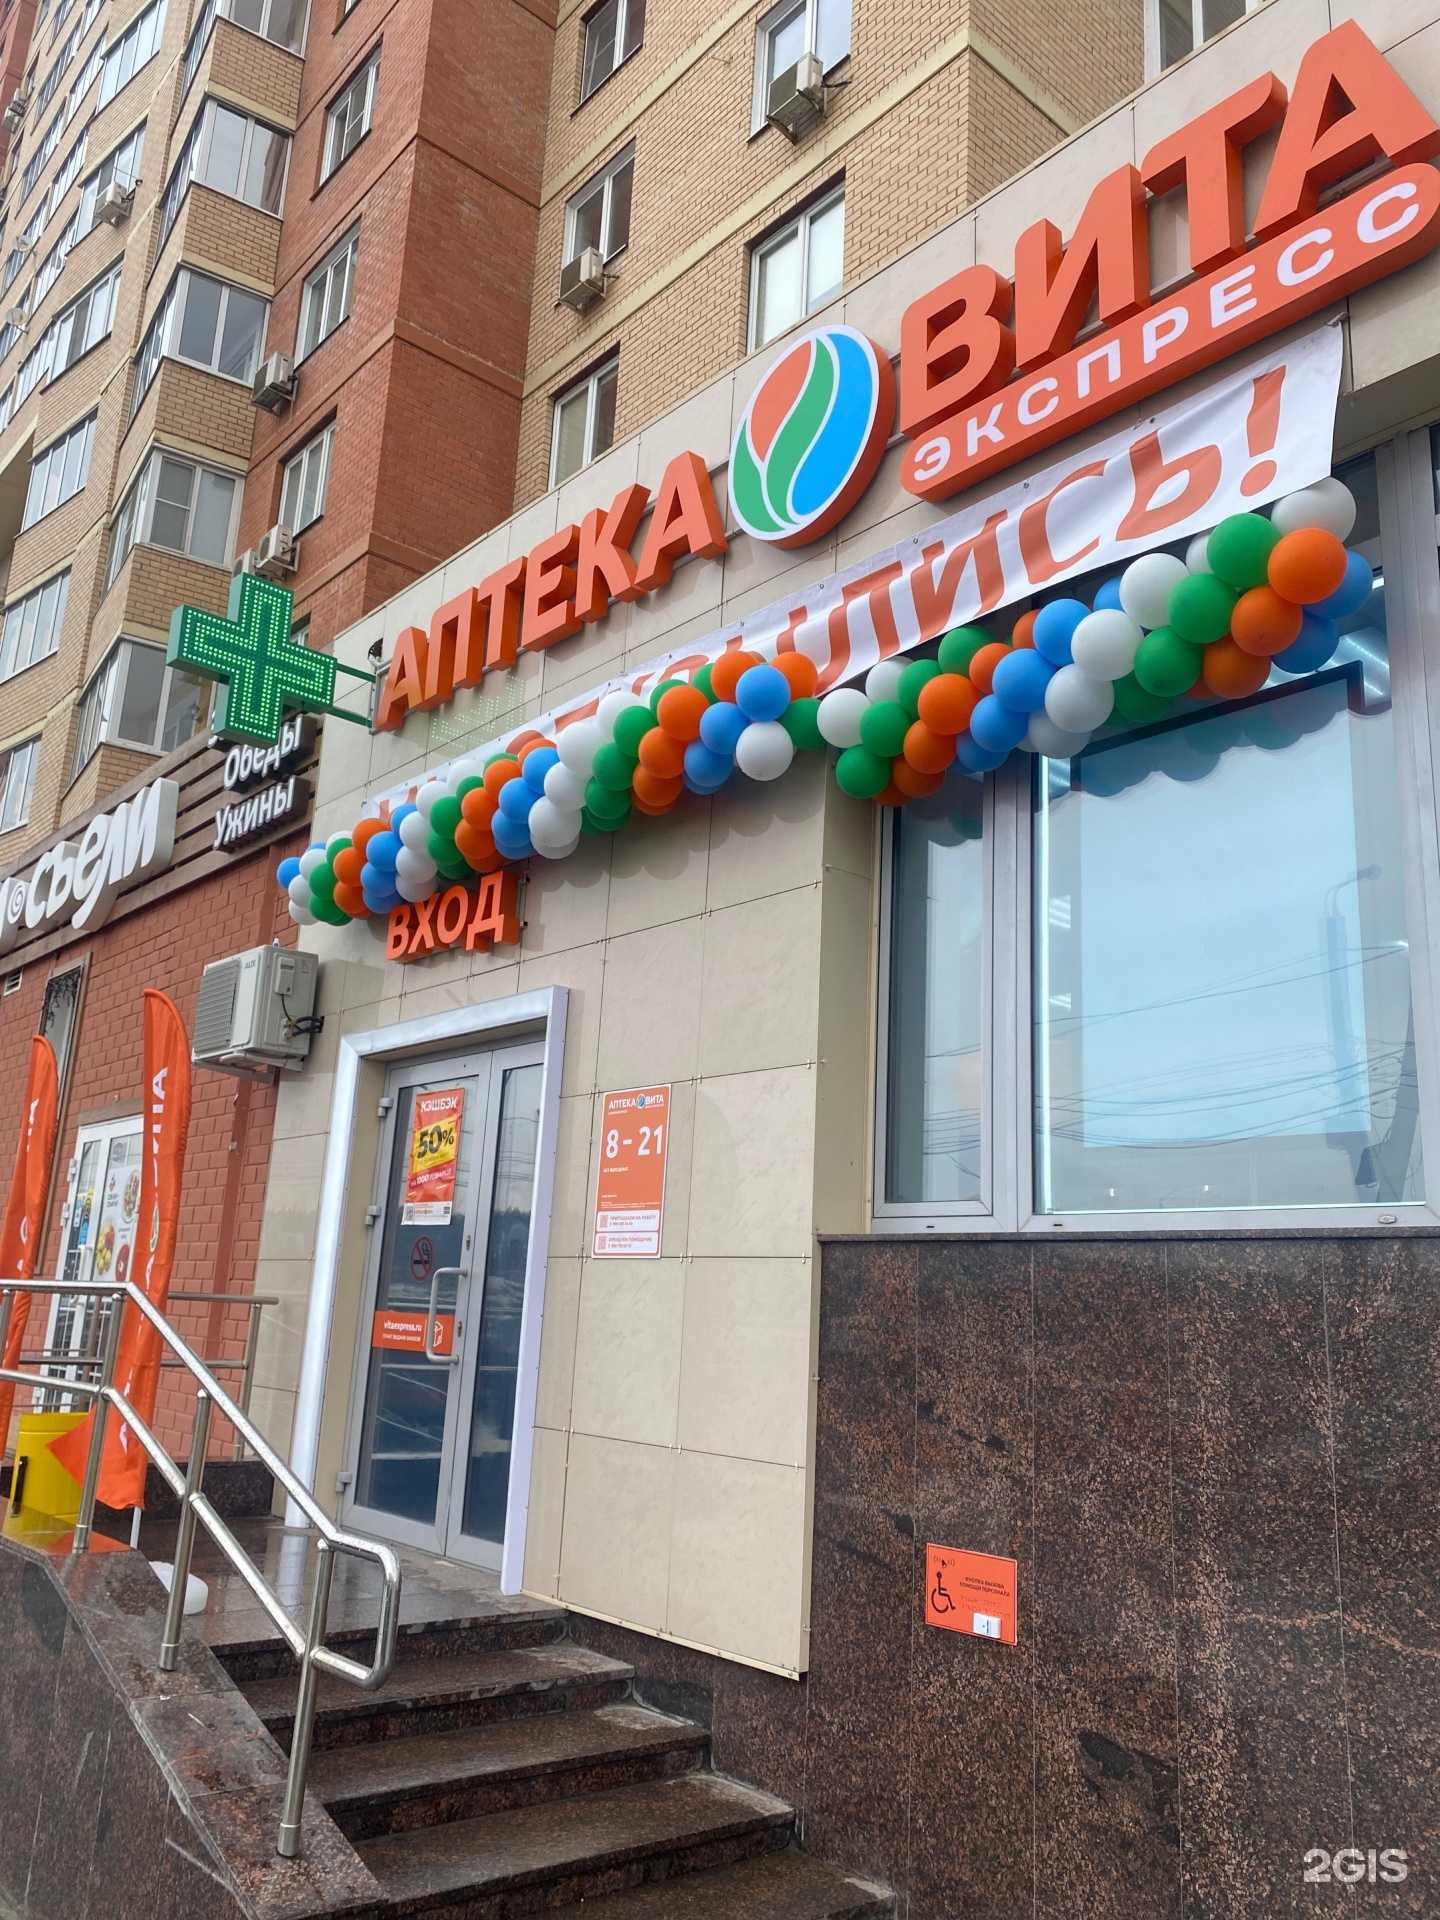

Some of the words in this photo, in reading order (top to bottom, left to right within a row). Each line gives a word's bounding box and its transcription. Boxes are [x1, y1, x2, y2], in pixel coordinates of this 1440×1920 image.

[901, 19, 1440, 435] ВИТА
[913, 183, 1420, 481] ЭКСПРЕСС
[375, 451, 724, 730] АПТЕКА
[223, 714, 303, 790] Обеды
[213, 775, 295, 850] Ужины
[386, 870, 505, 961] ВХОД
[416, 1125, 455, 1159] 50%
[608, 1098, 636, 1110] АПТЕКА
[645, 1094, 665, 1105] ВИТА
